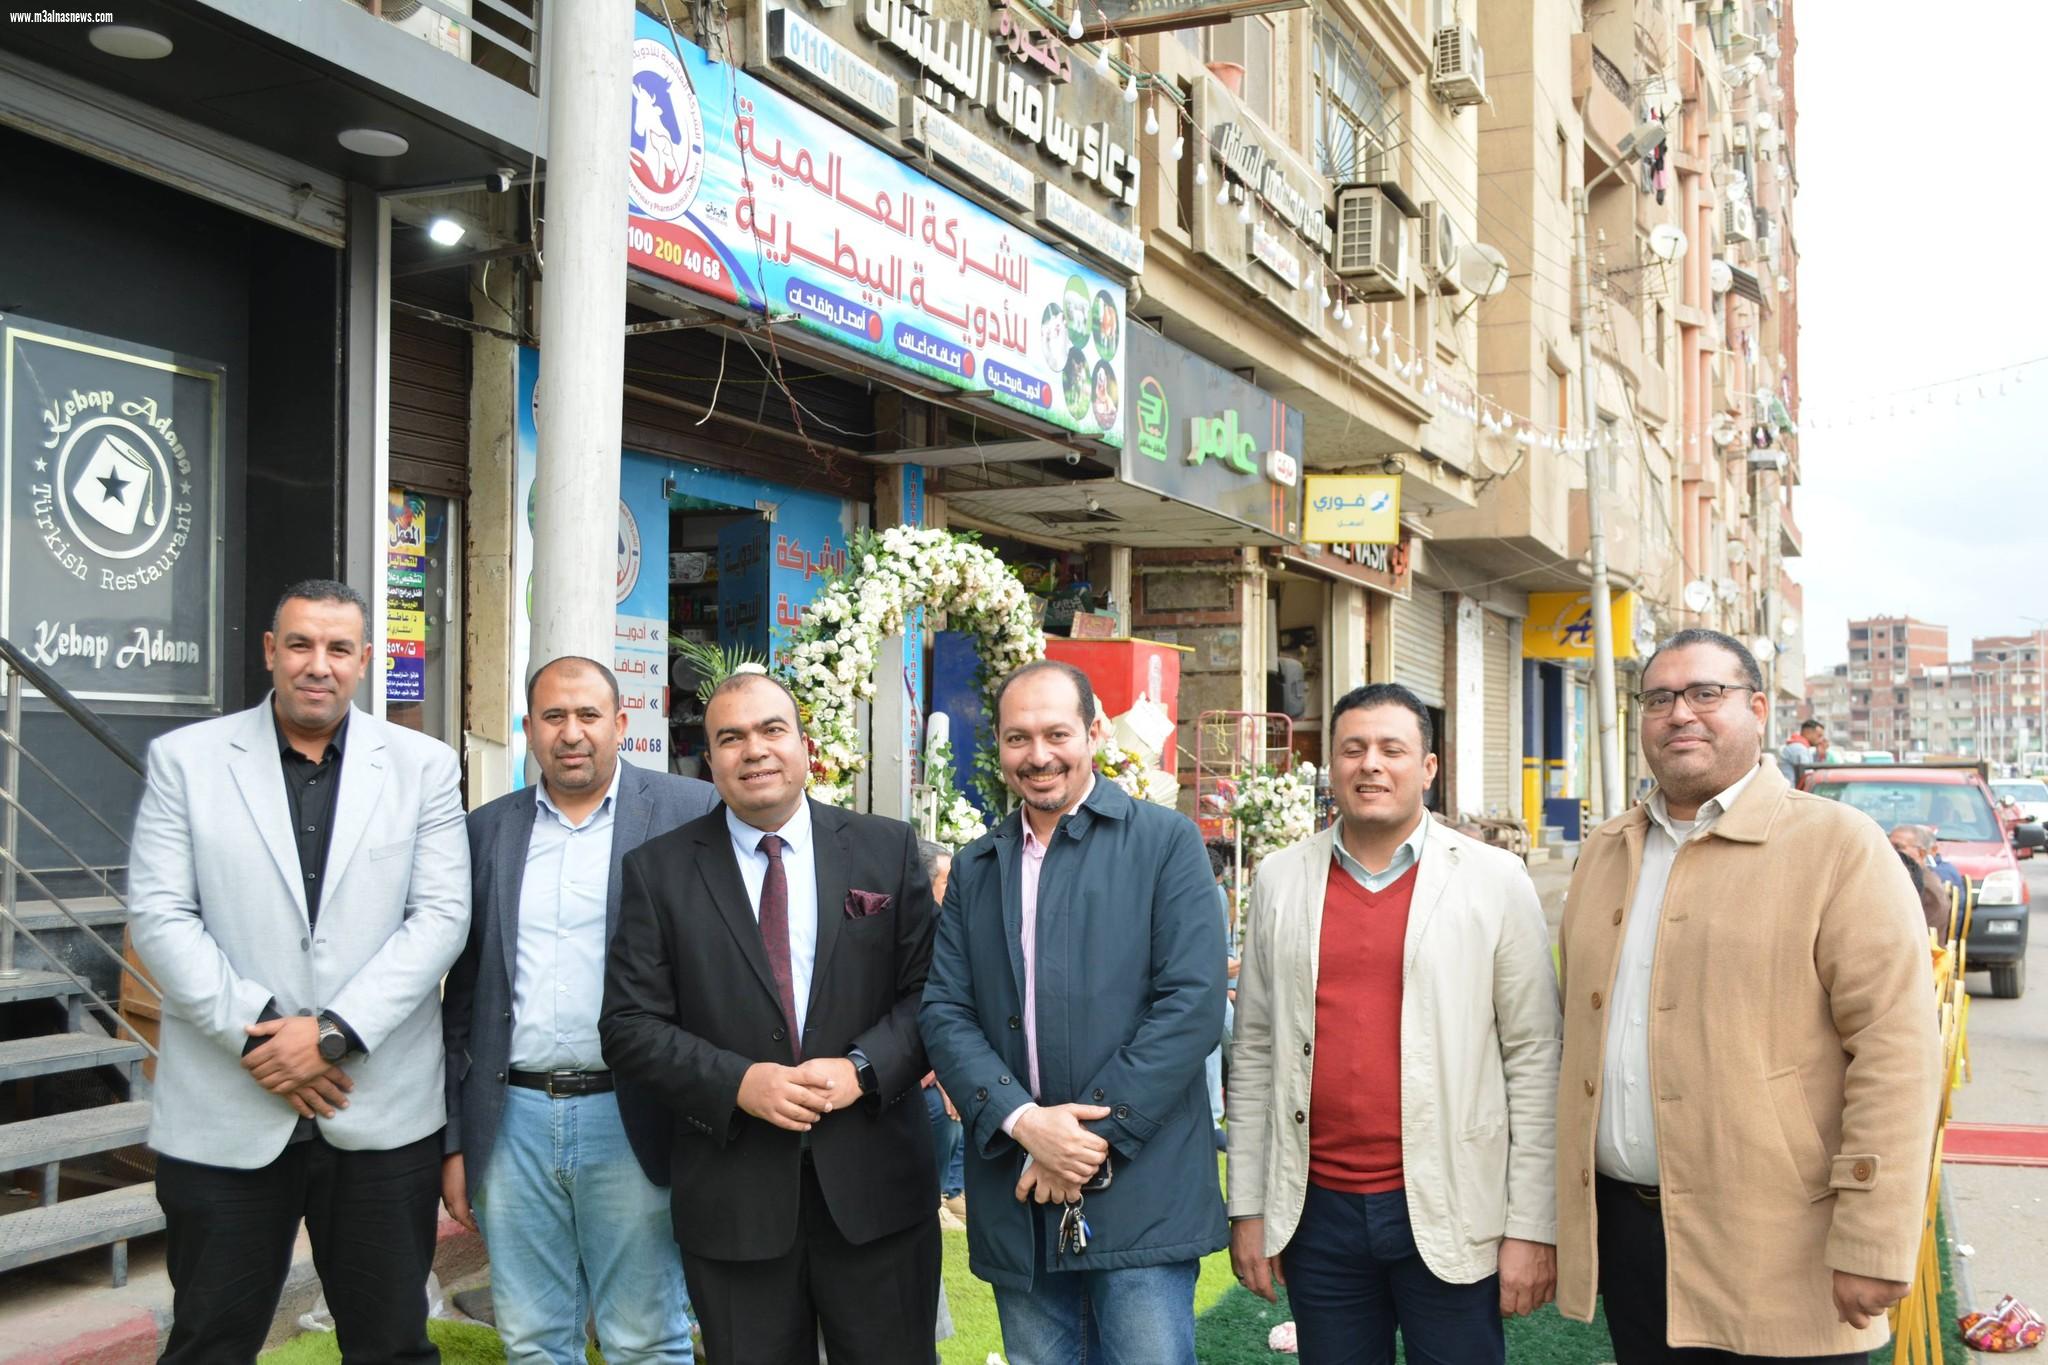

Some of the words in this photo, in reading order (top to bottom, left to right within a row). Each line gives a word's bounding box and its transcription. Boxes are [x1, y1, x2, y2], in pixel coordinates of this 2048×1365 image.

[789, 23, 895, 115] 01101102709
[734, 96, 914, 238] العالمية
[655, 236, 682, 265] 200
[684, 249, 701, 273] 40
[703, 256, 720, 281] 68
[735, 177, 902, 307] البيطرية
[921, 199, 1028, 294] الشركة
[789, 287, 834, 321] ولقاحات
[834, 305, 866, 331] أمصال
[909, 261, 1027, 354] للأدوية
[898, 332, 927, 356] أعلاف
[927, 343, 961, 373] إضافات
[988, 366, 1017, 393] بيطرية
[1017, 377, 1041, 400] أدوية
[44, 389, 114, 449] Kebap
[120, 397, 192, 476] Adana
[1187, 409, 1258, 475] عامر
[1313, 493, 1366, 512] فوري
[32, 483, 88, 580] Türkish
[100, 502, 192, 591] Restaurant
[776, 535, 847, 581] الشركة
[22, 620, 109, 669] Kebap
[115, 626, 200, 669] Adana
[614, 658, 646, 678] إضافا
[618, 737, 634, 752] 00
[635, 738, 648, 752] 40
[649, 738, 662, 753] 68
